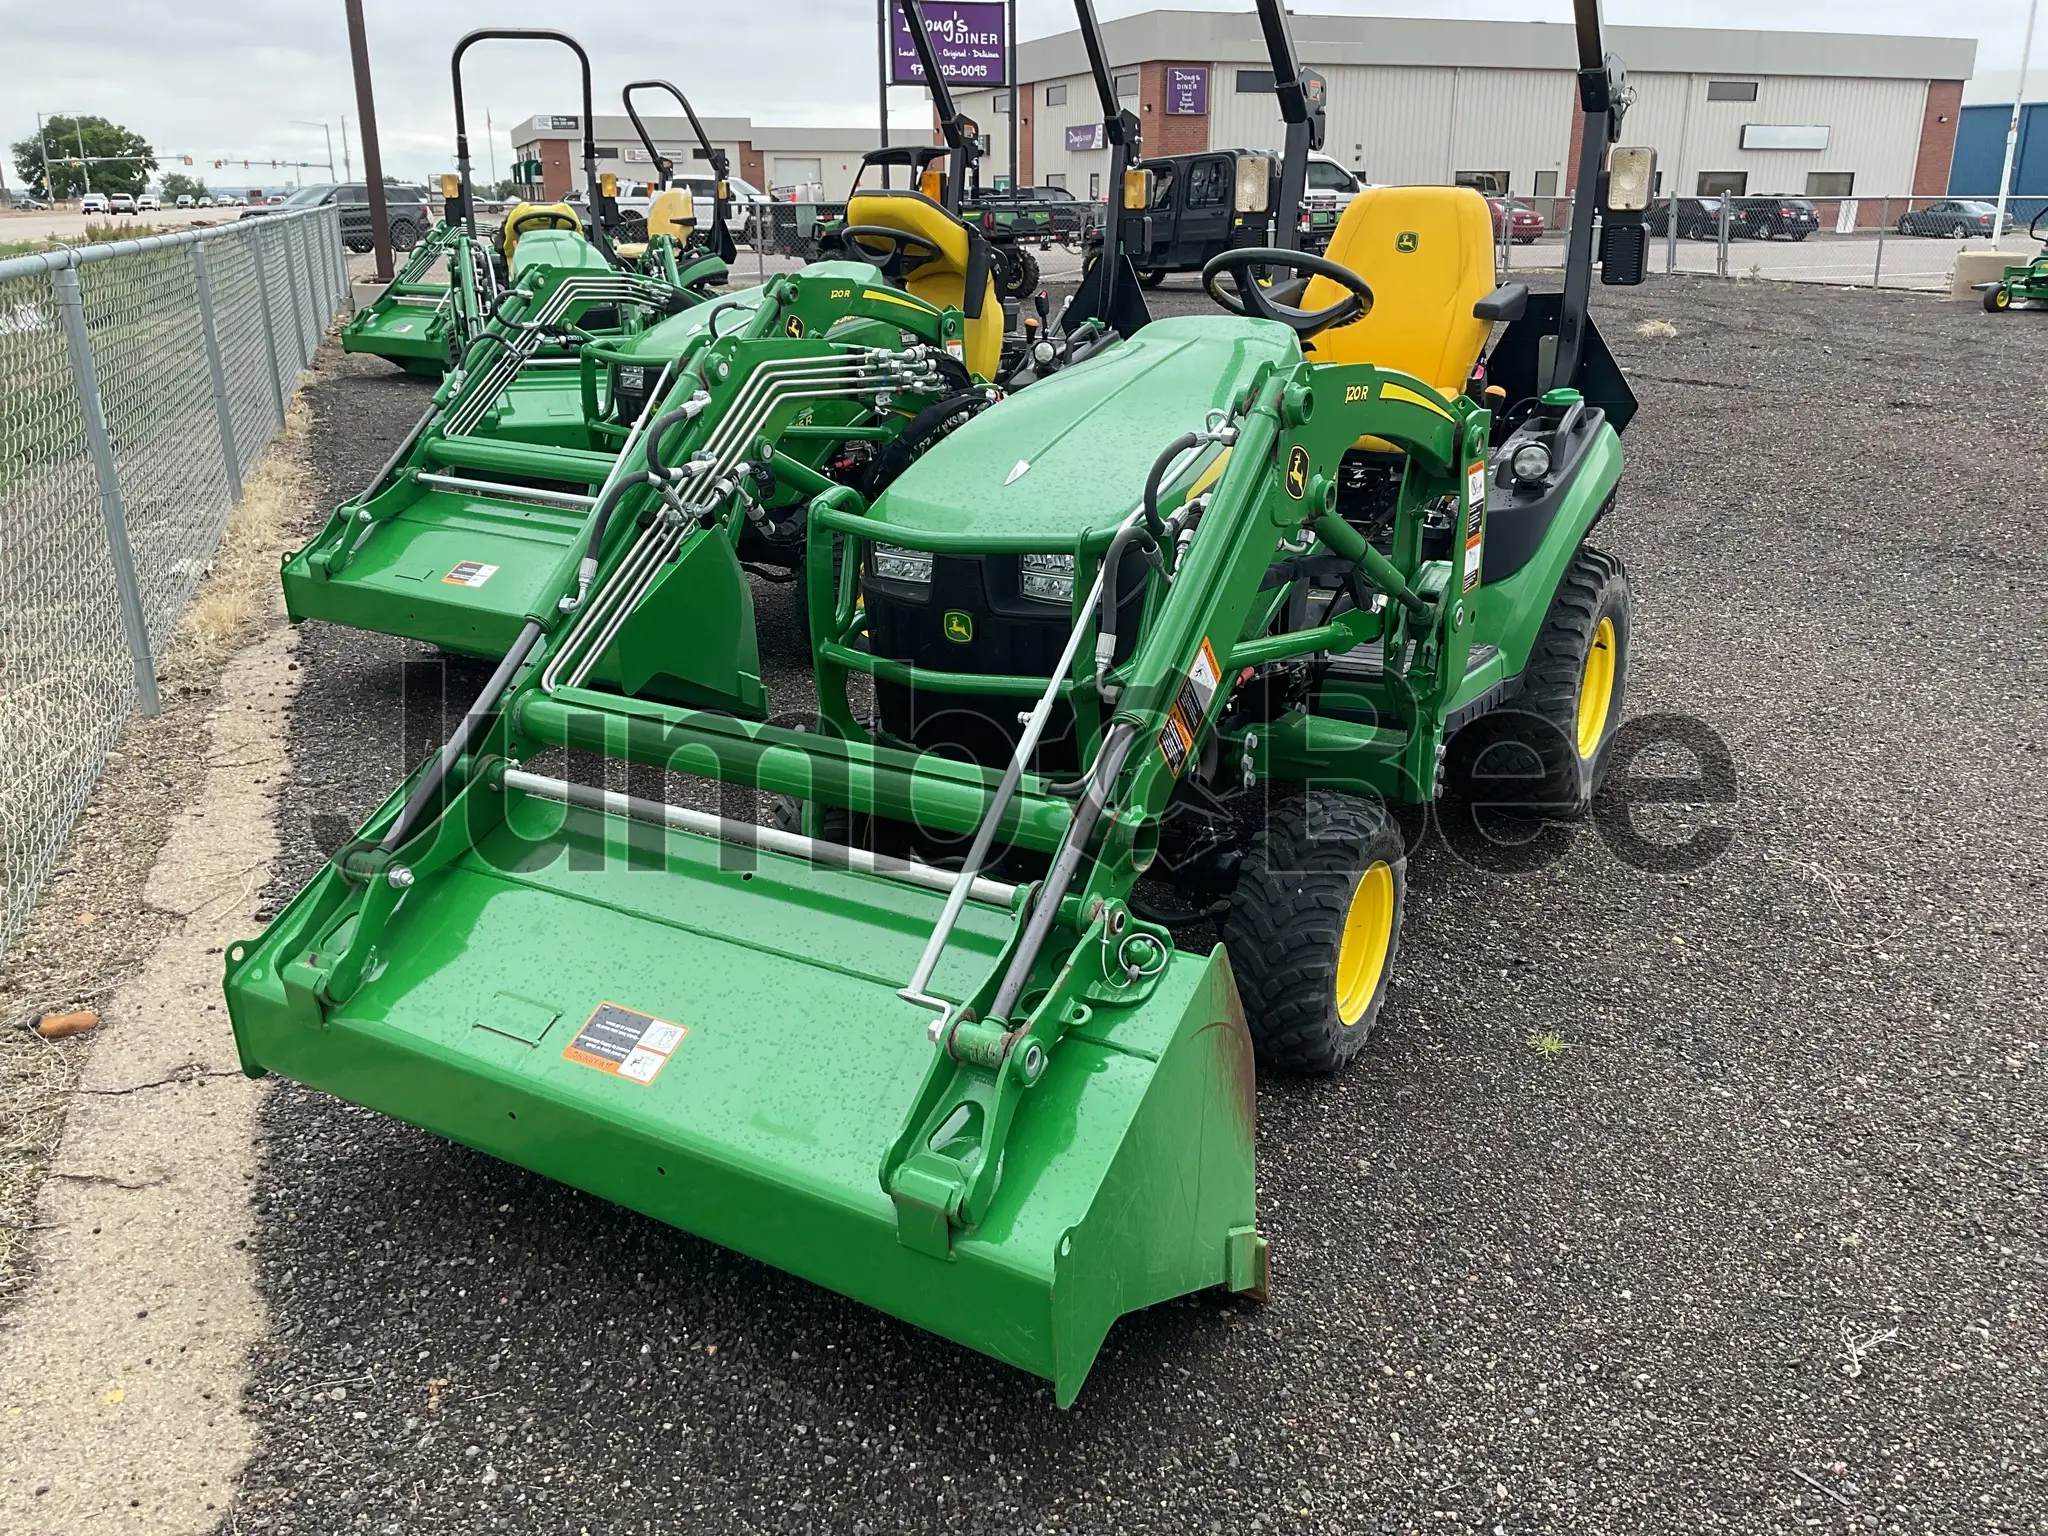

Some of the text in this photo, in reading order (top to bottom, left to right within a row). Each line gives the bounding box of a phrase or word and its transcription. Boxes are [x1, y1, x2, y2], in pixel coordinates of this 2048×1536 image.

[955, 32, 998, 44] DINER
[898, 47, 1000, 60] Local Original Delicious
